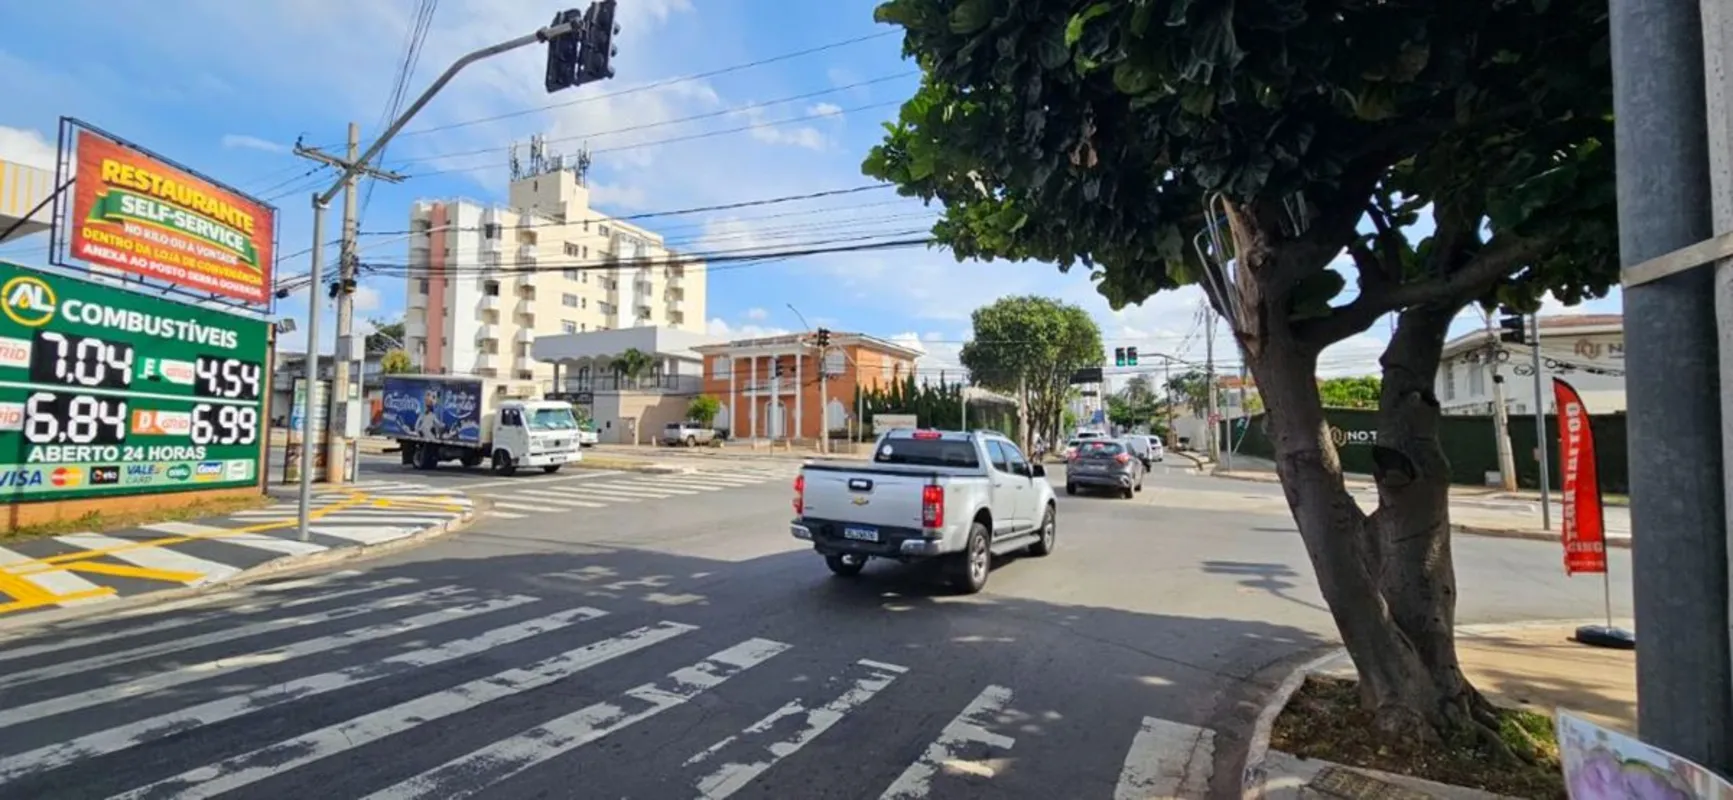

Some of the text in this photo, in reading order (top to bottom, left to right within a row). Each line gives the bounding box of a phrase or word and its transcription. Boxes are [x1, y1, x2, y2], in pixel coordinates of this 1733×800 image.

[102, 158, 254, 231] RESTAURANTE
[120, 194, 244, 252] SELF-SERVICE
[124, 223, 141, 236] NO
[143, 229, 169, 245] KILO
[170, 238, 186, 251] OU
[82, 227, 133, 250] DENTRO
[135, 242, 152, 254] DA
[153, 248, 181, 263] LOJA
[182, 255, 197, 269] DE
[83, 243, 128, 264] ANEXA
[129, 255, 148, 269] AO
[149, 260, 187, 279] POSTO
[187, 270, 220, 287] SERRA
[61, 299, 238, 349] COMBUSTÍVEIS
[41, 331, 134, 386] 7,04
[196, 358, 260, 398] 4,54
[24, 392, 127, 444] 6,84
[191, 404, 257, 445] 6,99
[27, 445, 207, 463] ABERTO 24 HORAS
[126, 464, 156, 475] VALE
[0, 469, 43, 487] VISA
